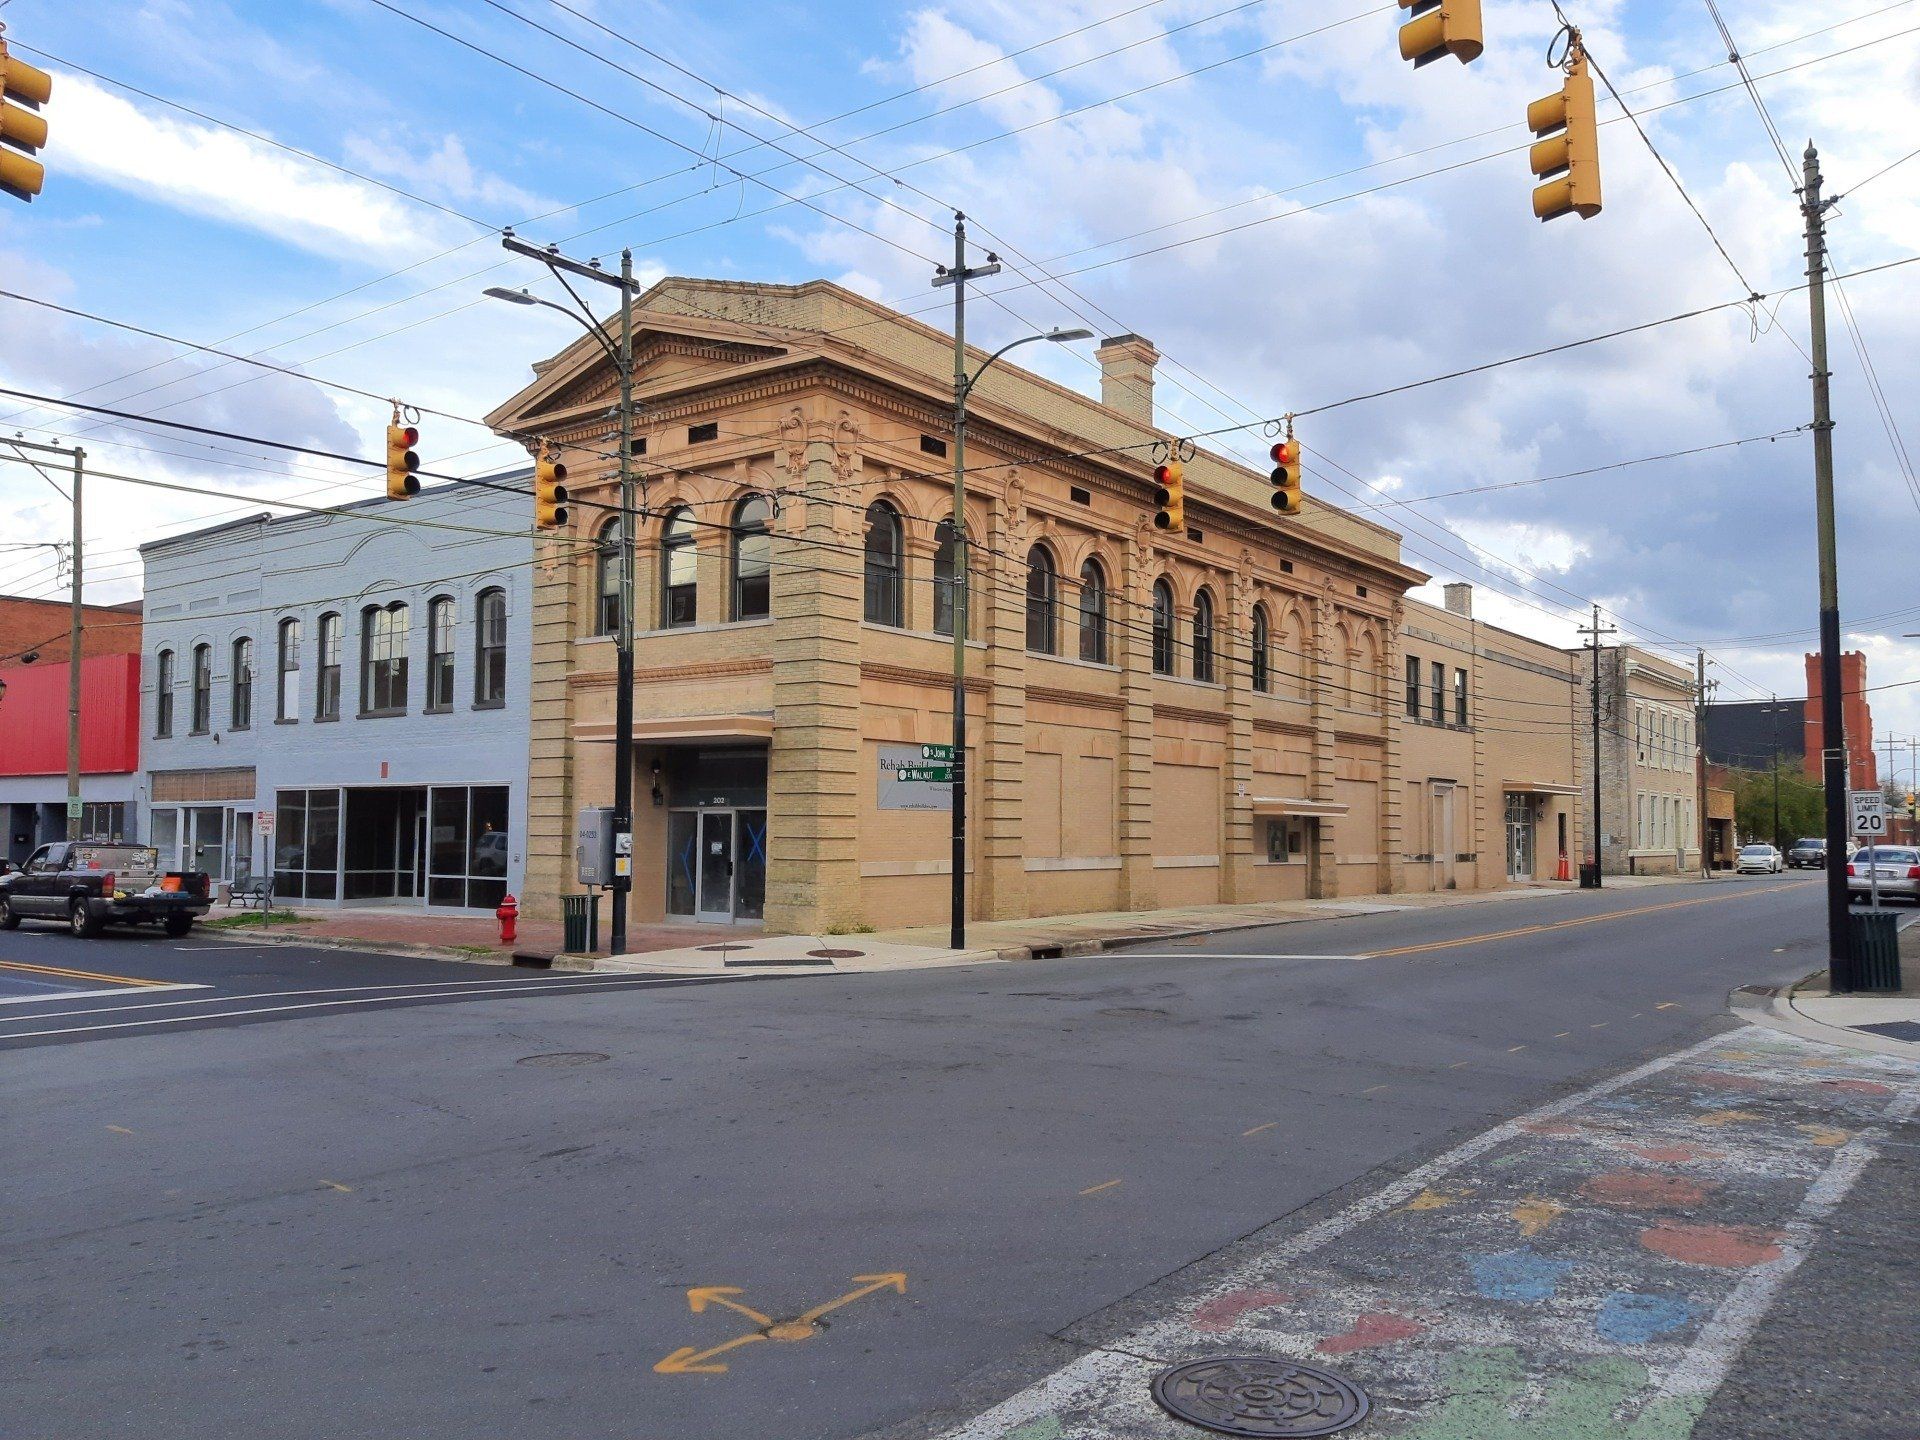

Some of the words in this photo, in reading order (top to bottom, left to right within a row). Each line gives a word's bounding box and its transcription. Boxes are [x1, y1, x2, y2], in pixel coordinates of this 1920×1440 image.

[934, 747, 946, 758] JOHN
[880, 759, 905, 770] Rehab
[911, 769, 934, 779] WALNUT
[1854, 796, 1880, 804] SPEED
[1856, 804, 1878, 812] LIMIT
[1856, 815, 1881, 830] 20
